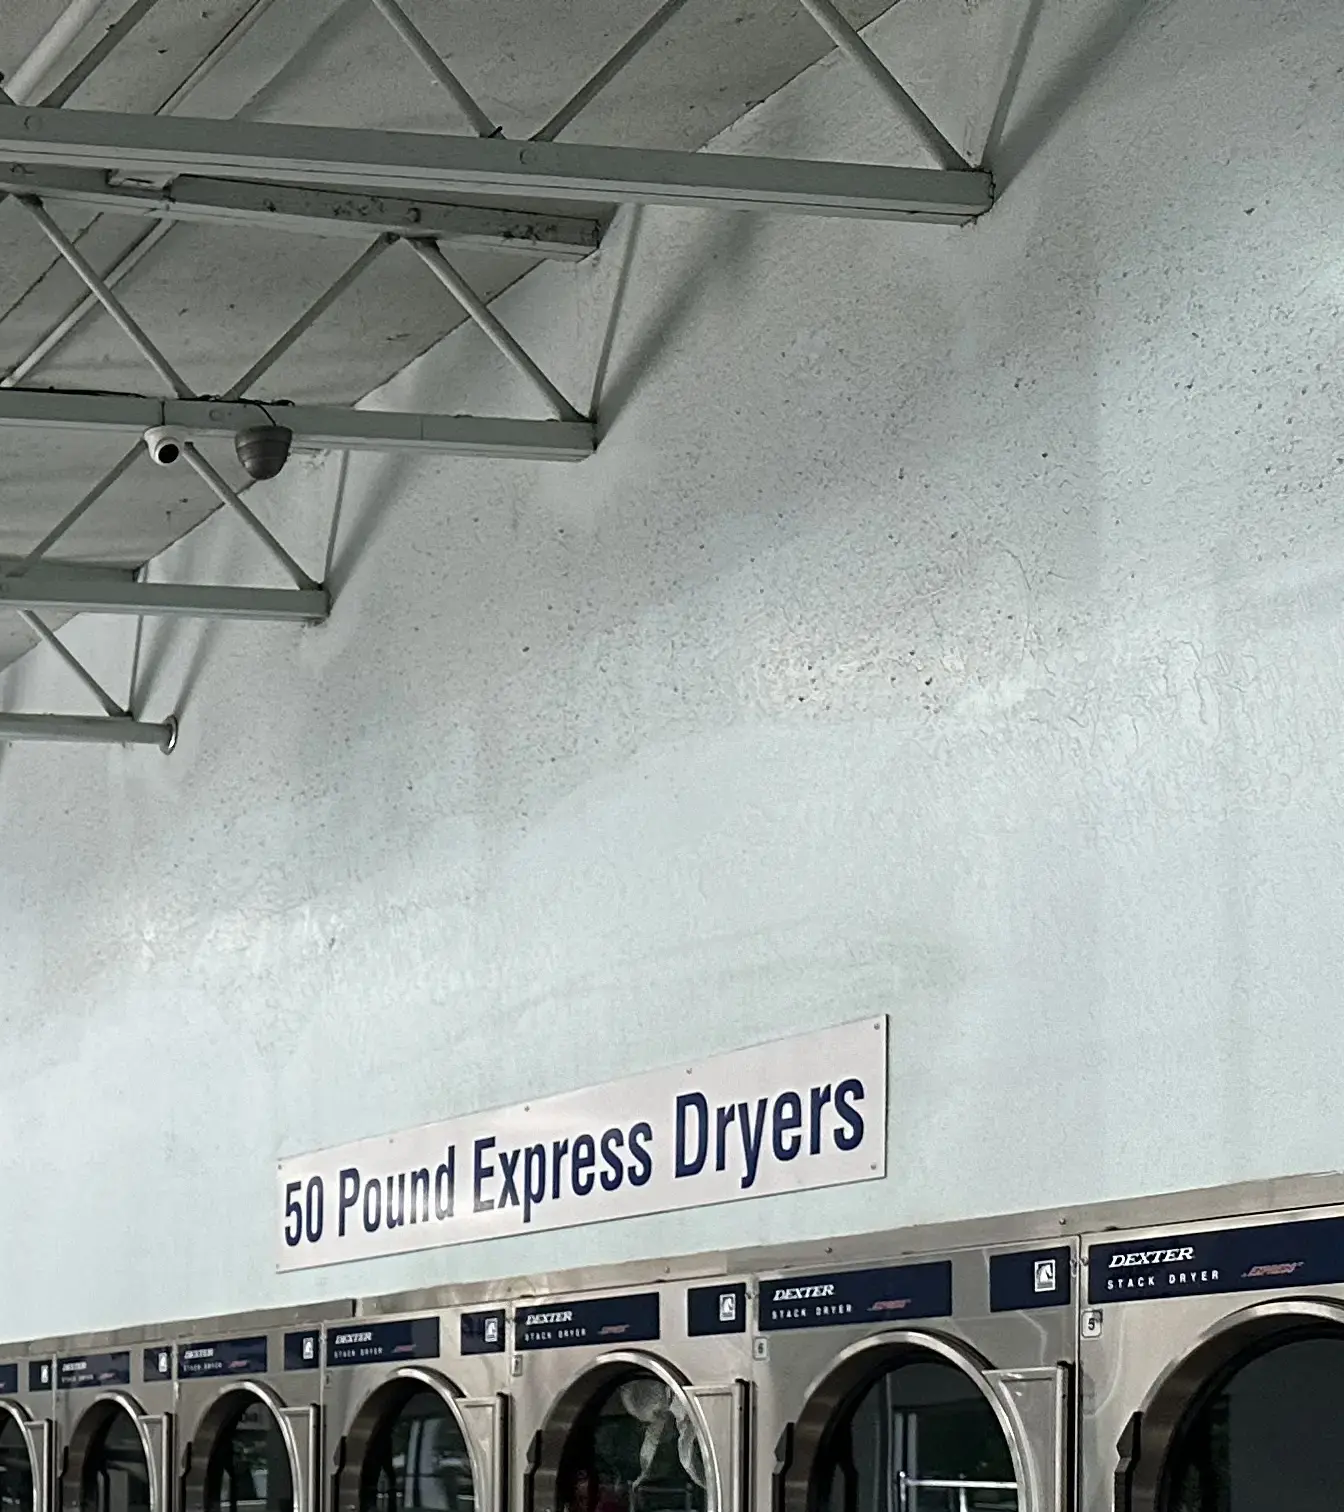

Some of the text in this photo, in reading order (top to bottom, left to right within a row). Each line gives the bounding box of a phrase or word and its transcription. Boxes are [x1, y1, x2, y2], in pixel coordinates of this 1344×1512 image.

[283, 1077, 865, 1248] 50 Pound Express Dryers
[1108, 1246, 1195, 1269] DEXTER
[1107, 1270, 1220, 1290] STACK DRYER
[773, 1283, 835, 1301] DEXTER
[525, 1310, 574, 1326] DEXTER
[771, 1307, 808, 1320] STACK
[815, 1303, 854, 1316] DRYER
[1088, 1317, 1096, 1331] 5
